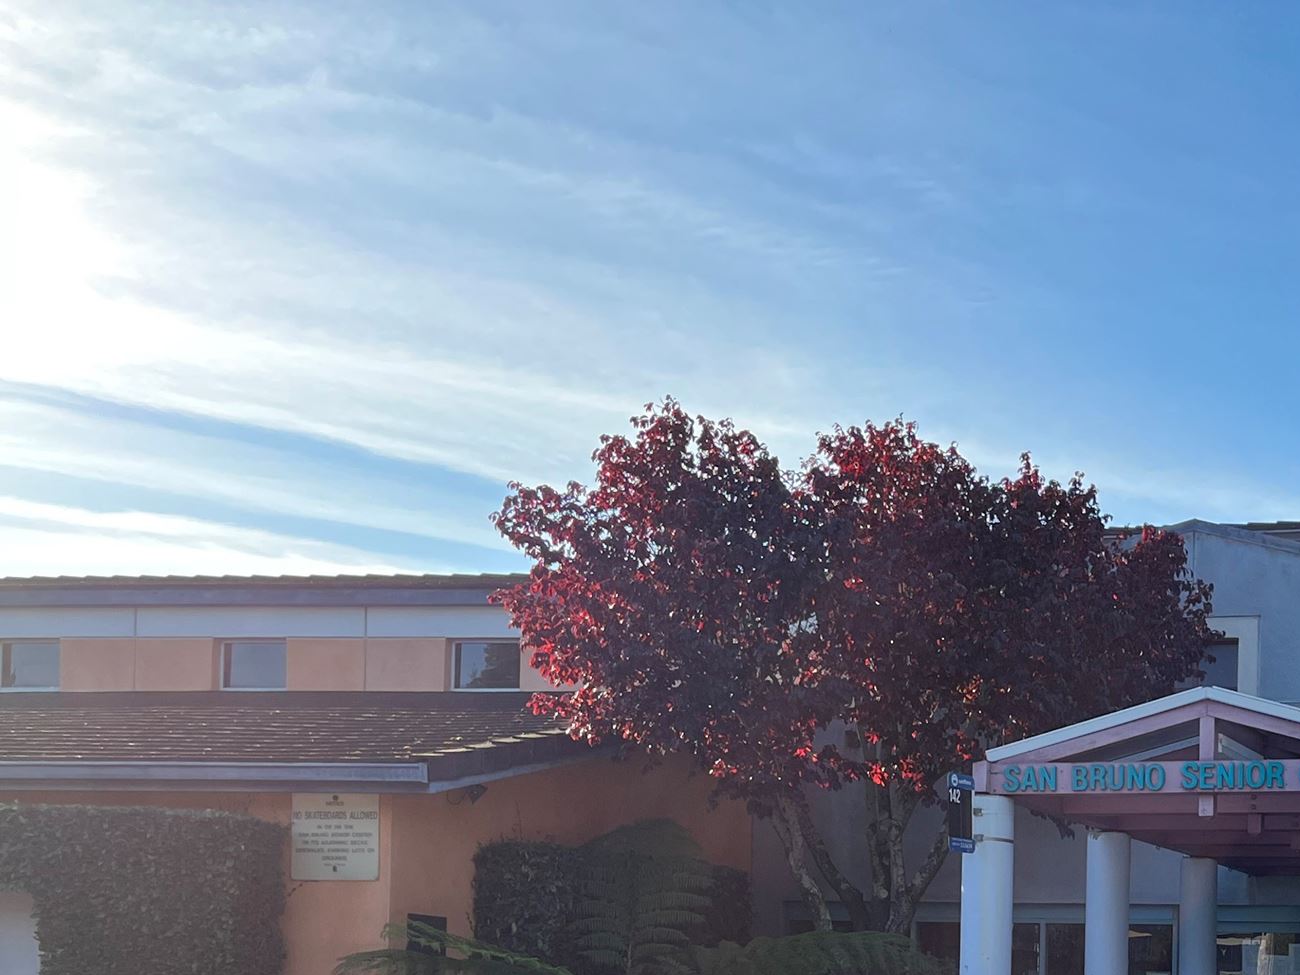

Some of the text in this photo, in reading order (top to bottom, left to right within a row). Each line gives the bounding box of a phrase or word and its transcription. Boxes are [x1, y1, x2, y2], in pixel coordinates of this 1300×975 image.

[1002, 765, 1057, 792] SAN
[1071, 763, 1166, 791] BRUNO
[1181, 761, 1285, 789] SENIOR
[949, 788, 960, 803] 142
